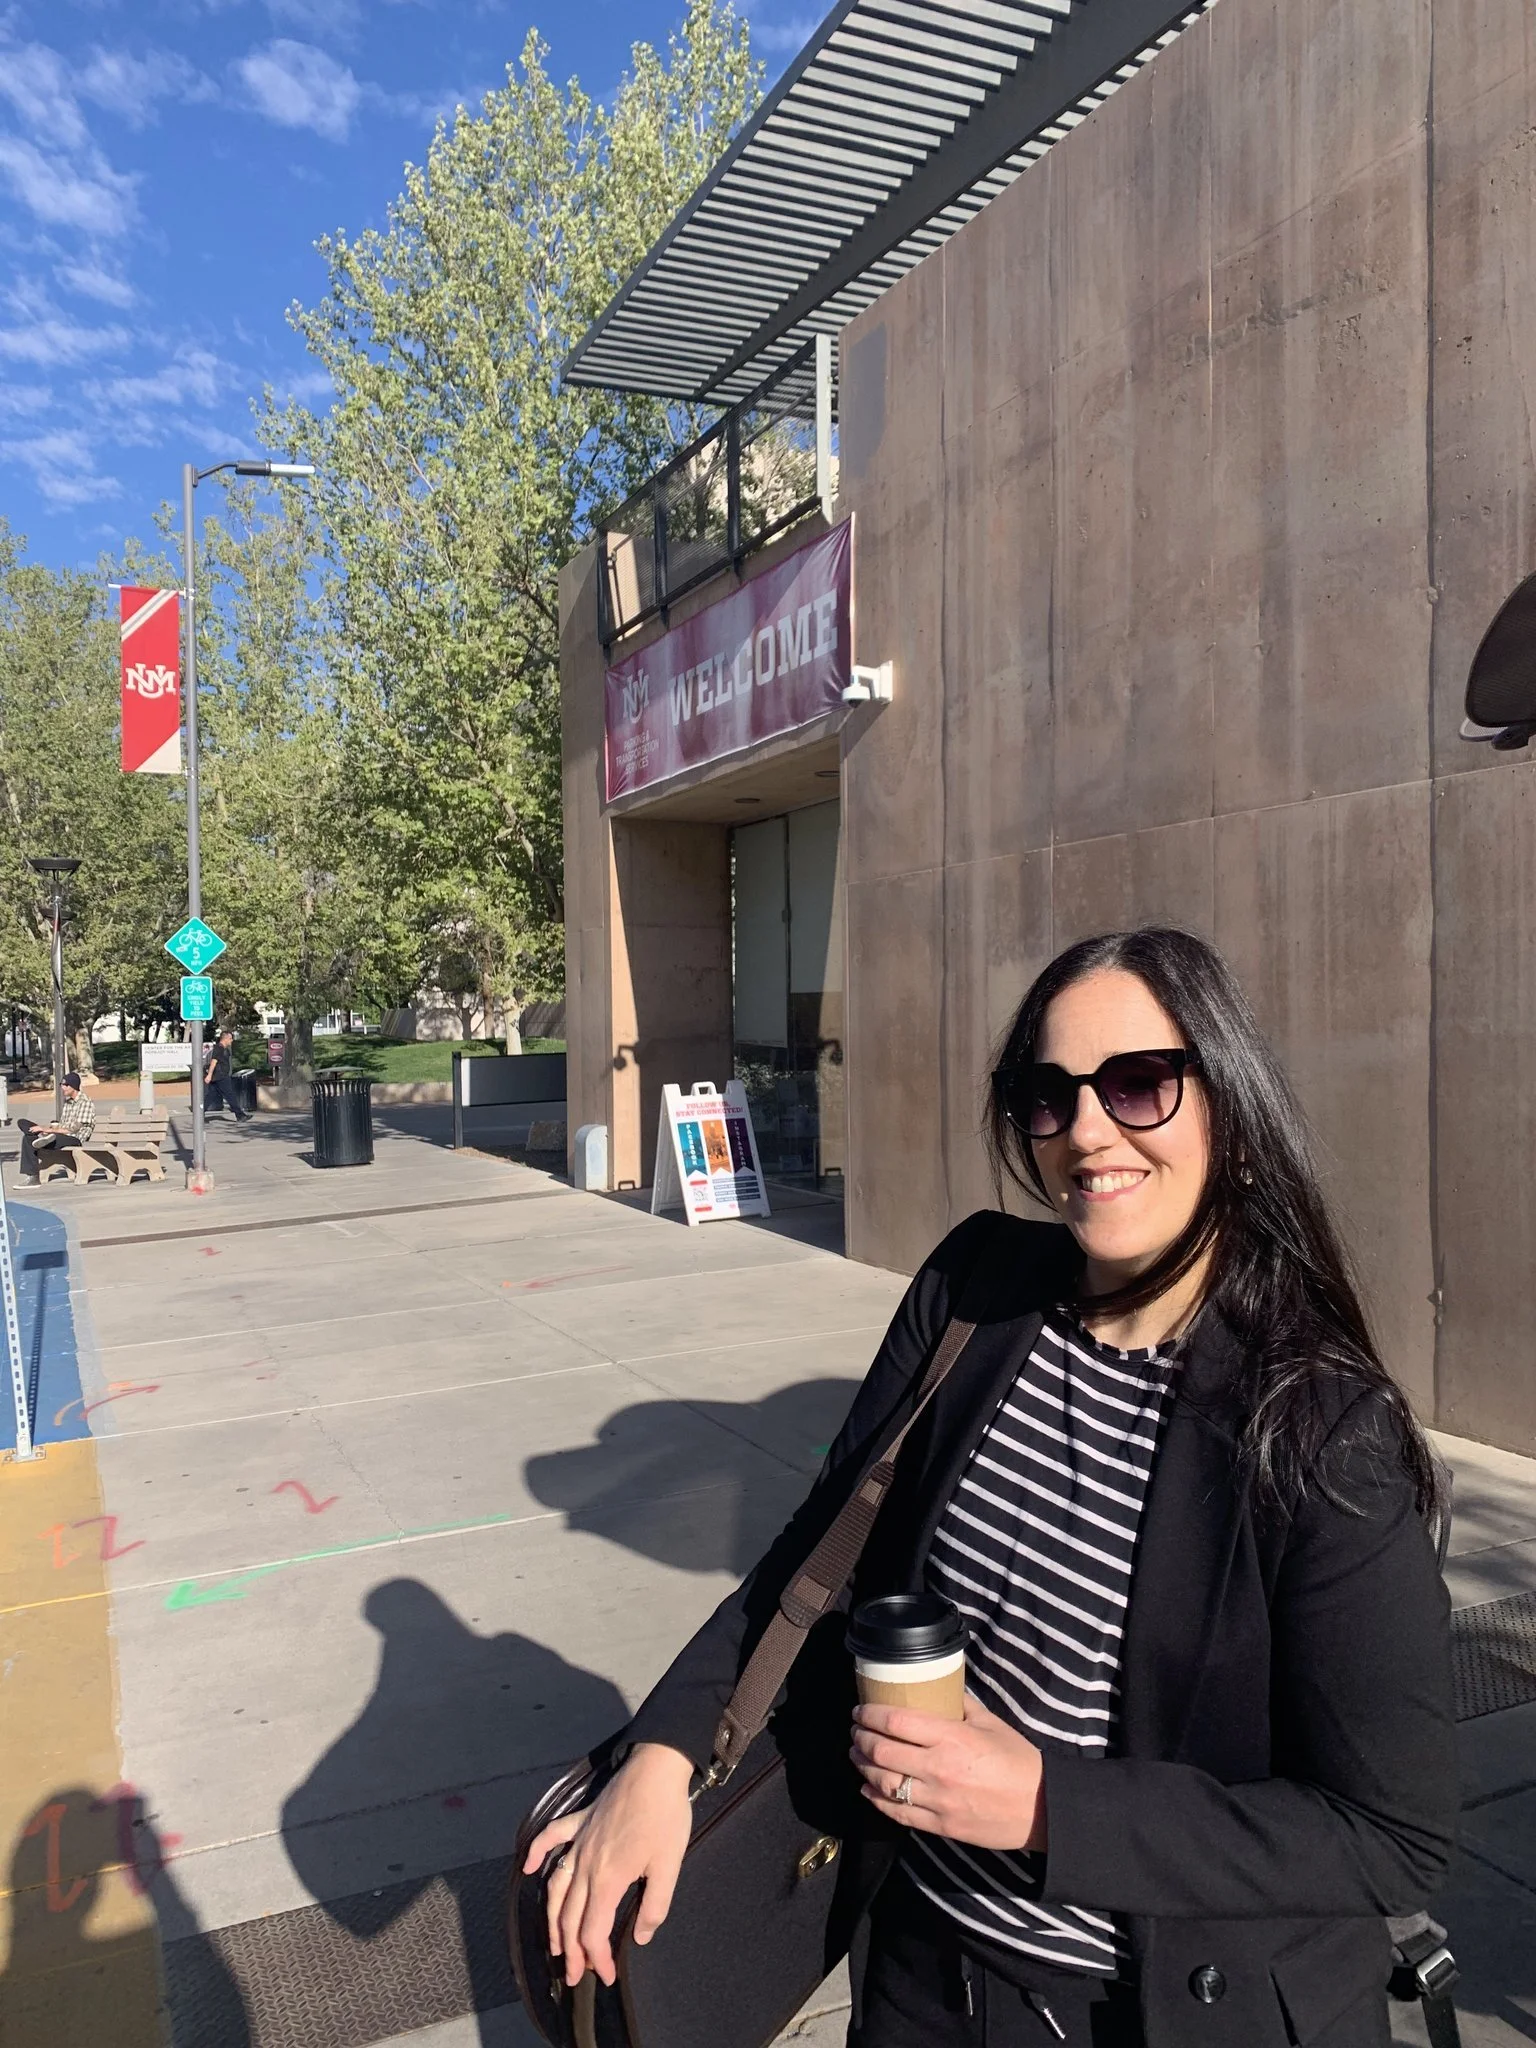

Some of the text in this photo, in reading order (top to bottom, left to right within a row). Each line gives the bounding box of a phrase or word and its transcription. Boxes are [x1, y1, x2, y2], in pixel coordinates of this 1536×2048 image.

[668, 588, 838, 727] WELCOME
[192, 947, 200, 960] 5
[686, 1101, 717, 1109] FOLLOW
[676, 1110, 695, 1118] STAY
[734, 1120, 747, 1167] INSTAGRAM
